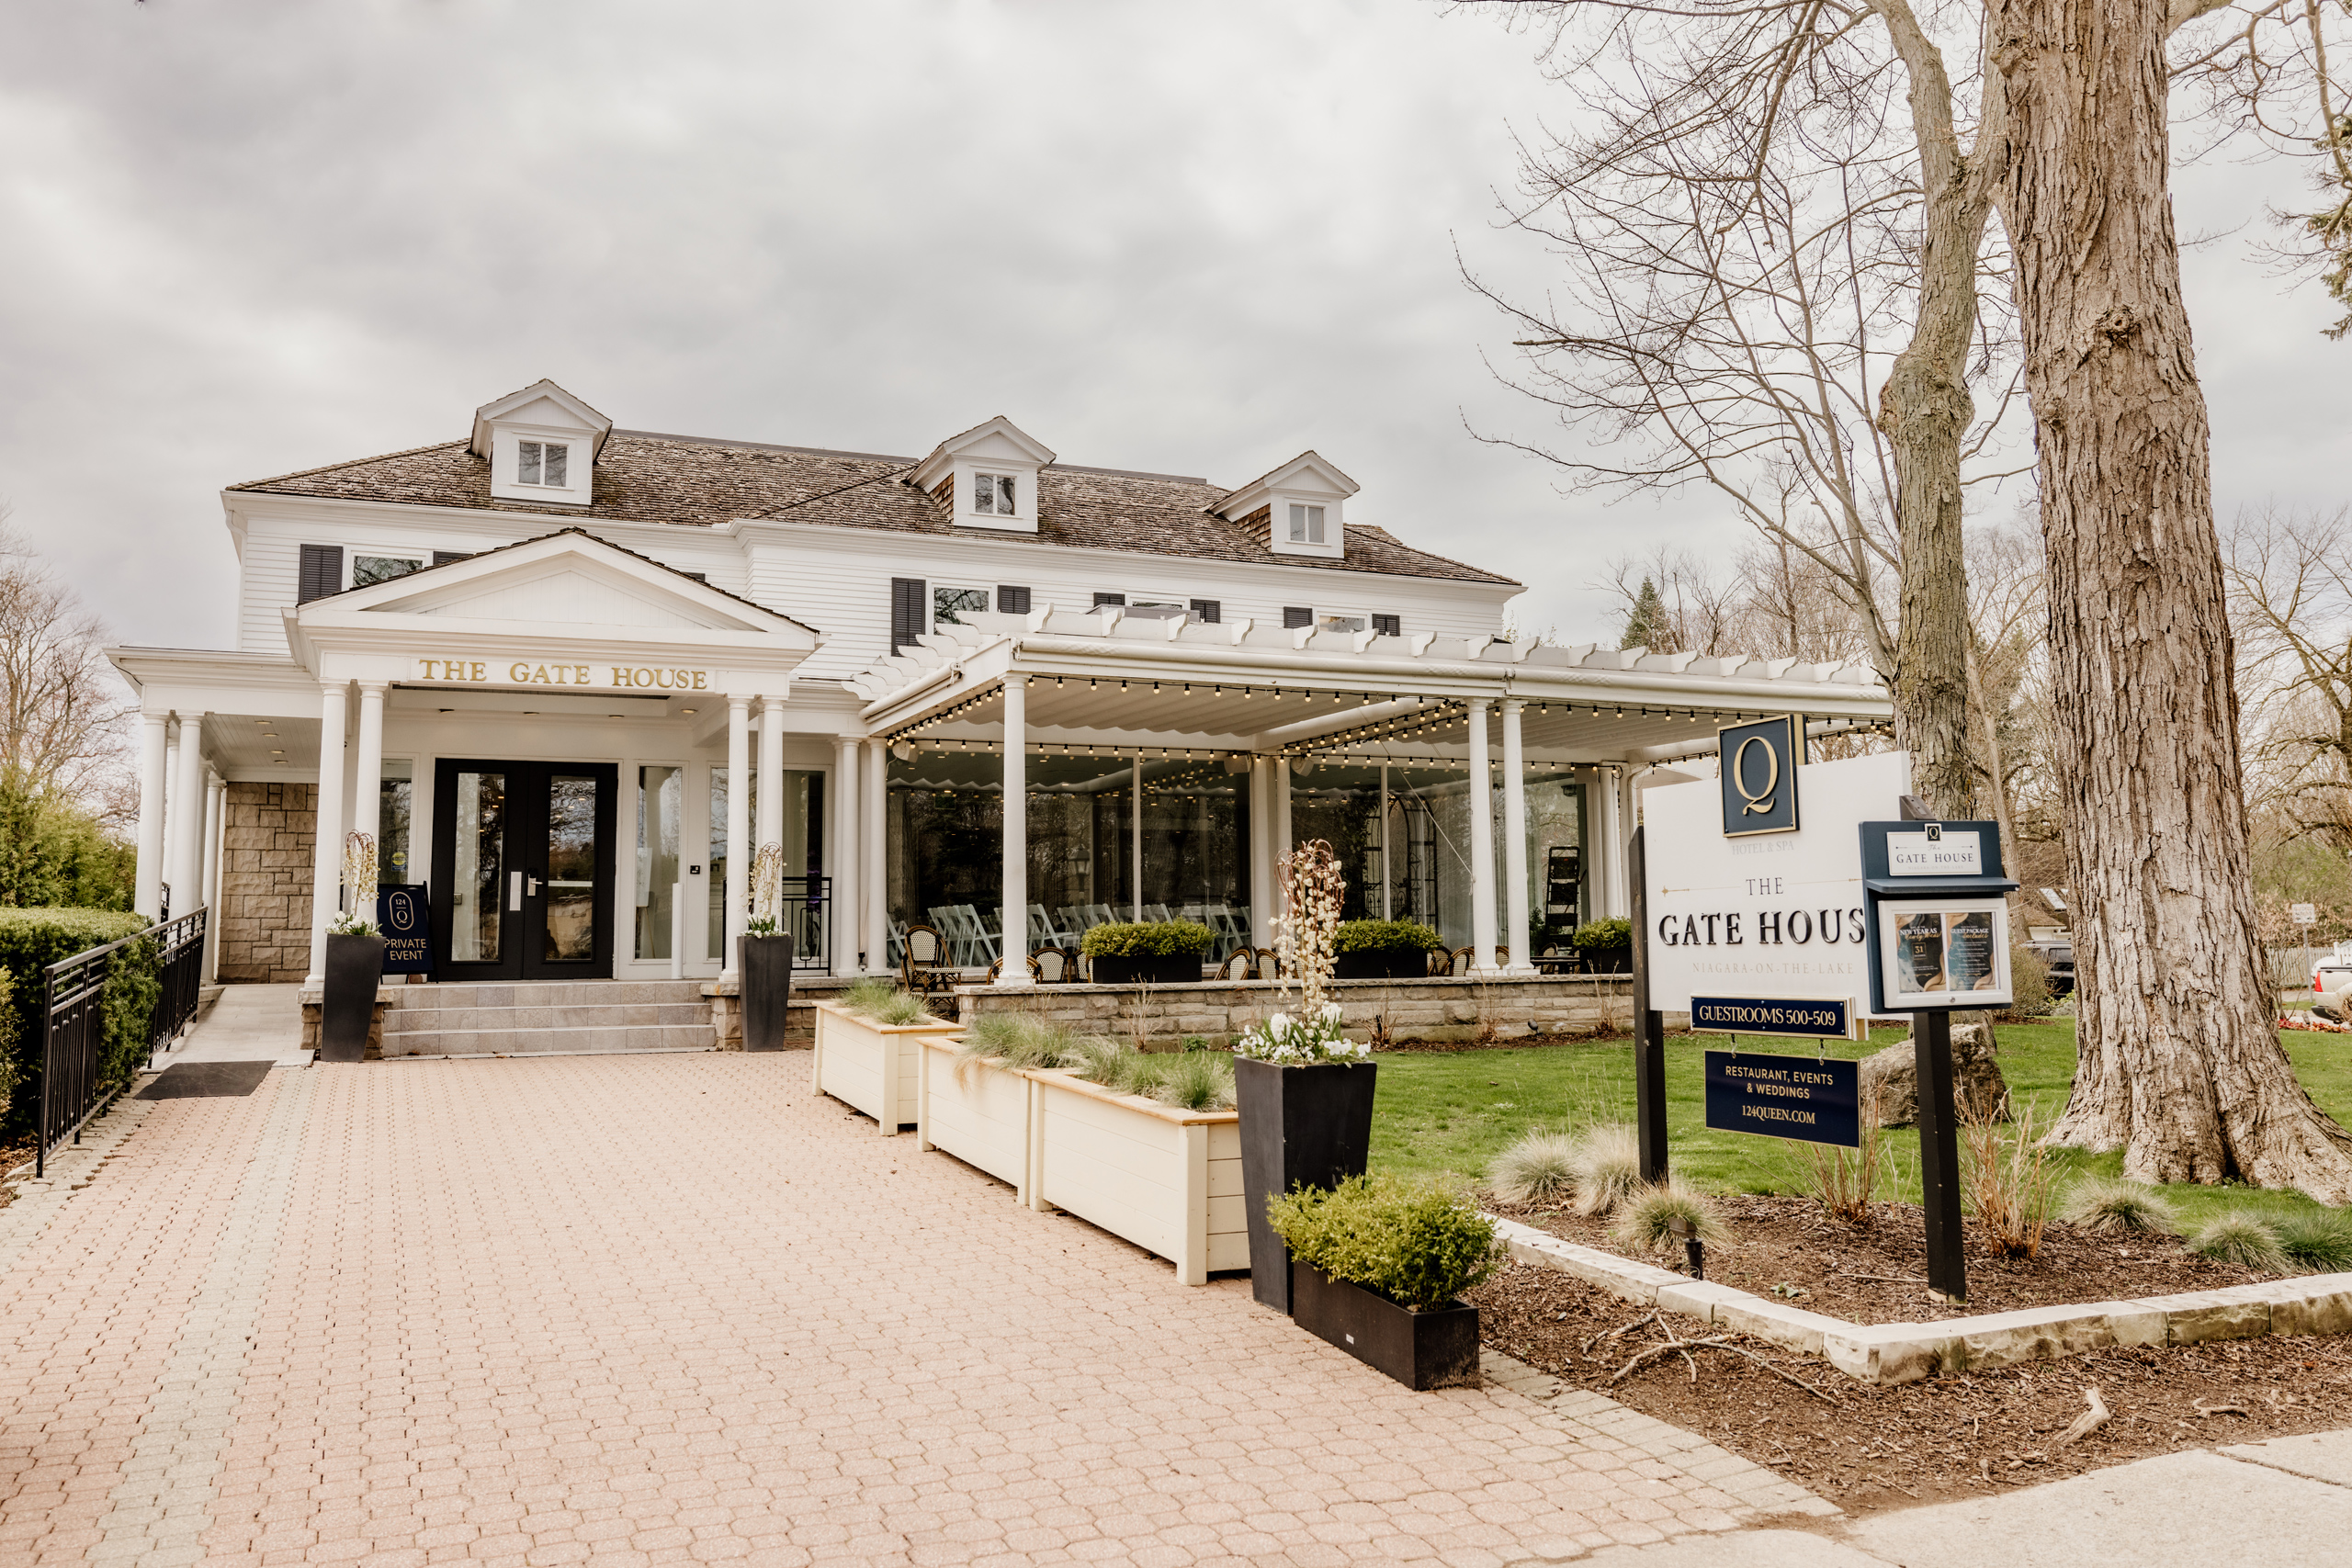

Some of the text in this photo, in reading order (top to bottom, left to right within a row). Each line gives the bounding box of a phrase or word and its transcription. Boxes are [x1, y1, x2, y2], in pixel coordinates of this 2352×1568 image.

[419, 659, 707, 690] THE GATE HOUSE
[1734, 736, 1778, 816] Q
[1928, 827, 1939, 840] Q
[1732, 840, 1794, 855] HOTEL & SPA
[1896, 852, 1974, 863] GATE HOUSE
[1746, 877, 1784, 897] THE
[396, 910, 408, 924] Q
[1658, 907, 1865, 946] GATE HOUS
[384, 938, 427, 949] PRIVATE
[1915, 945, 1924, 954] 31
[390, 950, 424, 961] EVENT
[1692, 963, 1854, 975] NIAGARA-ON-THE-LAKE
[1700, 1005, 1836, 1026] GUESTROOMS 500-509
[1725, 1066, 1834, 1086] RESTAURANT, EVENTS
[1747, 1083, 1810, 1100] & WEDDINGS
[1742, 1105, 1816, 1124] 124QUEEN.COM
